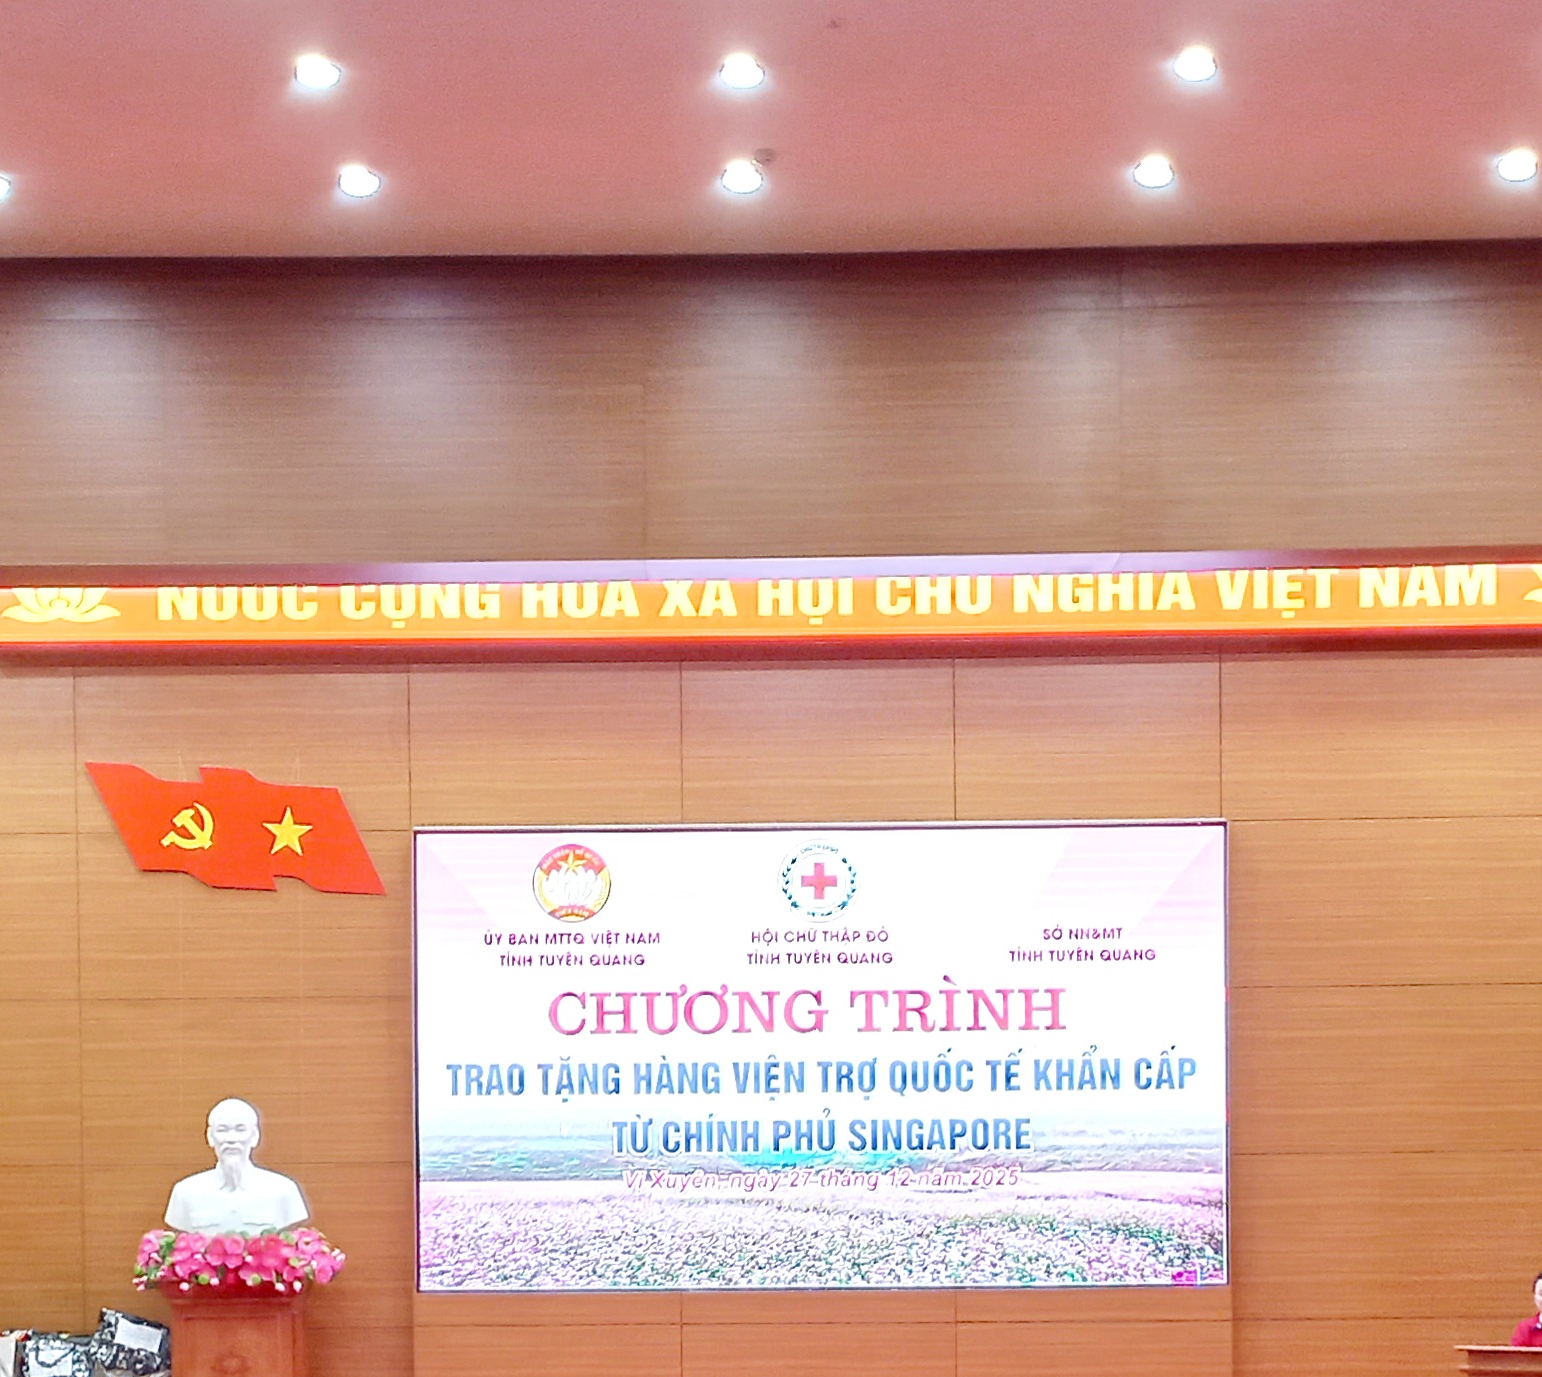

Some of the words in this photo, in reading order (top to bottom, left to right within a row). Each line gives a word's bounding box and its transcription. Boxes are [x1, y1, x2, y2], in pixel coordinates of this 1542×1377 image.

[509, 933, 538, 945] BAN
[545, 933, 585, 945] MTTQ
[591, 930, 620, 948] VIỆT
[626, 932, 660, 944] NAM
[752, 928, 778, 946] HỘI
[784, 928, 817, 942] CHỮ
[822, 927, 860, 946] THẬP
[1069, 927, 1122, 939] NN&MT
[539, 952, 583, 966] TUYÊN
[590, 954, 645, 966] QUANG
[786, 950, 831, 964] TUYÊN
[837, 952, 893, 964] QUANG
[1049, 947, 1093, 961] TUYÊN
[1100, 949, 1155, 961] QUANG
[548, 983, 829, 1036] CHƯƠNG
[850, 975, 1066, 1032] TRÌNH
[447, 1064, 524, 1095] TRAO
[537, 1056, 620, 1102] TẶNG
[634, 1056, 720, 1094] HÀNG
[733, 1054, 805, 1101] VIỆN
[816, 1057, 877, 1100] TRỢ
[890, 1049, 974, 1096] QUỐC
[986, 1049, 1020, 1092] TẾ
[1034, 1045, 1120, 1091] KHẨN
[1134, 1045, 1196, 1090] CẤP
[613, 1114, 653, 1153] TỪ
[663, 1114, 759, 1152] CHÍNH
[773, 1108, 835, 1151] PHỦ
[849, 1118, 1031, 1150] SINGAPORE
[972, 1170, 1018, 1185] 2025
